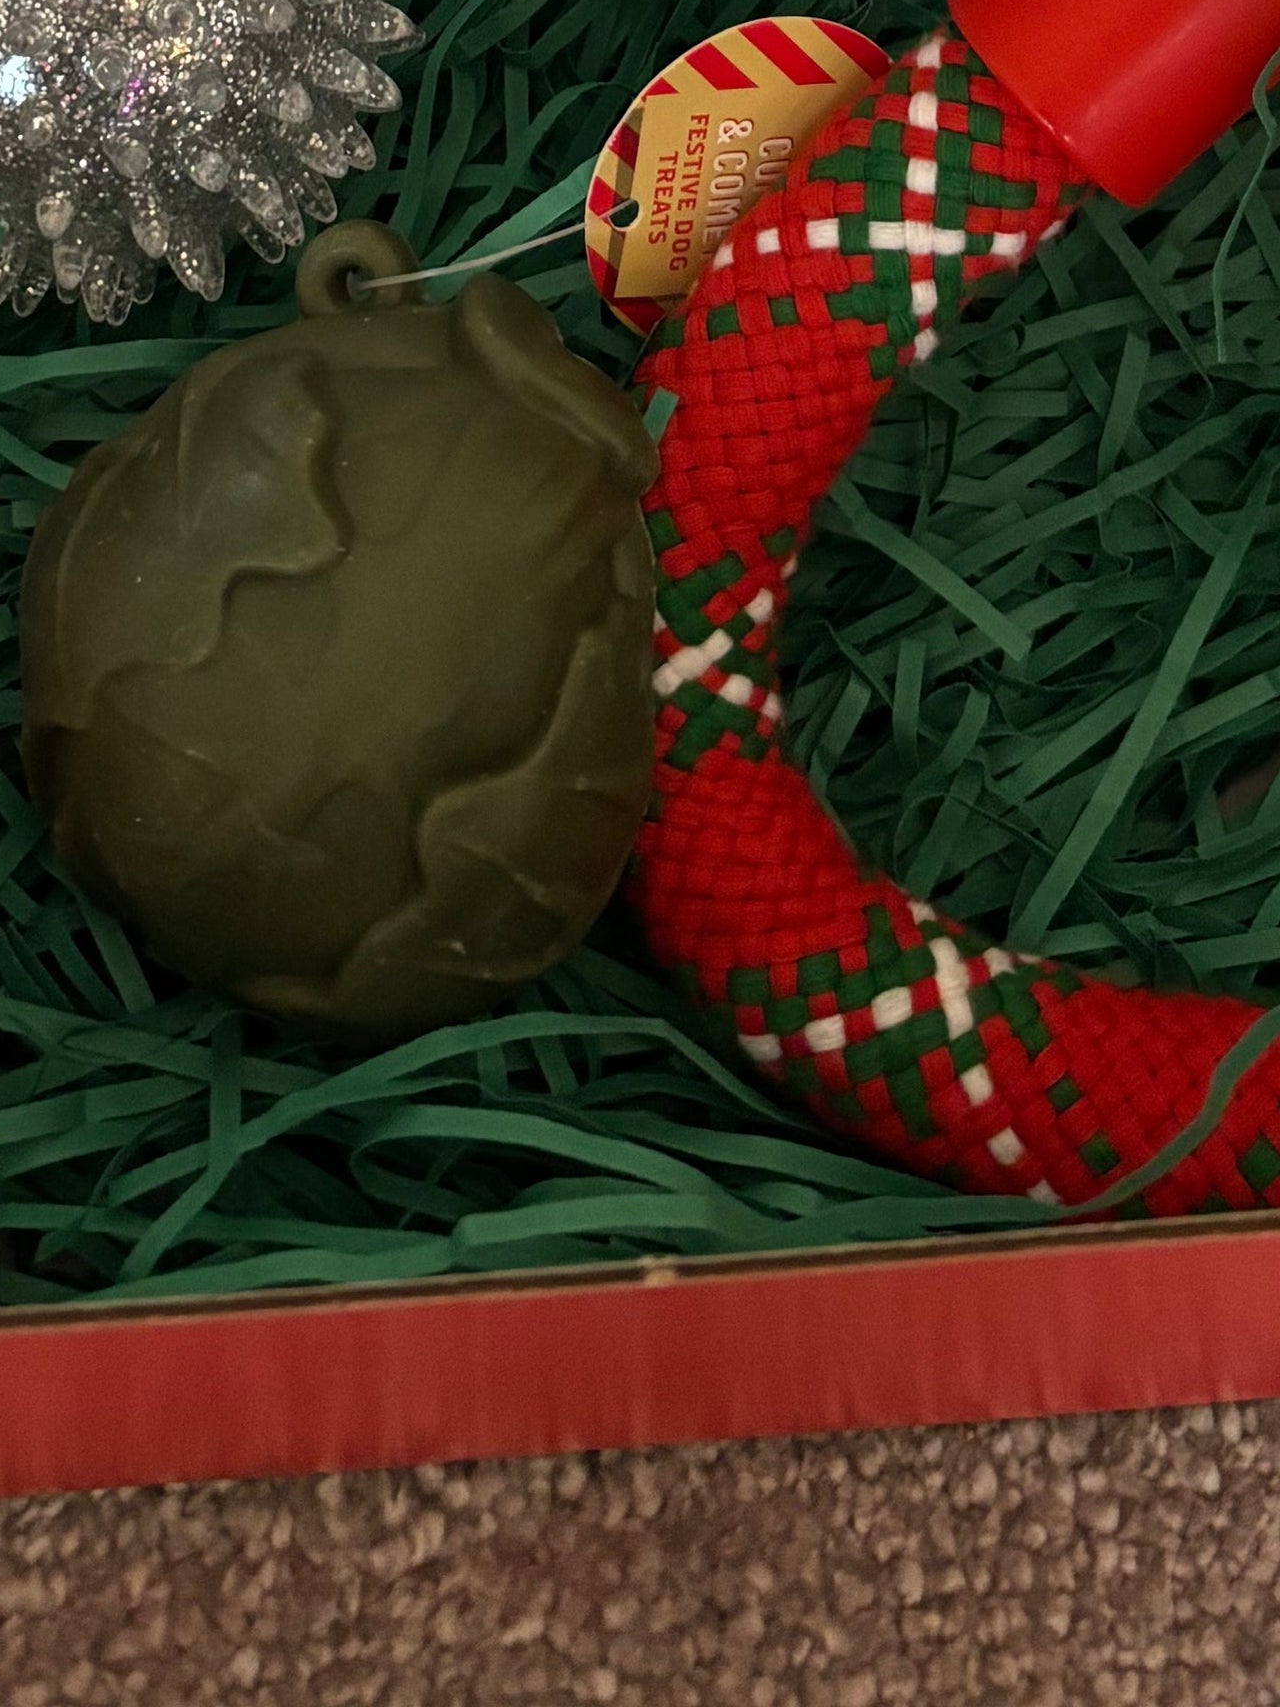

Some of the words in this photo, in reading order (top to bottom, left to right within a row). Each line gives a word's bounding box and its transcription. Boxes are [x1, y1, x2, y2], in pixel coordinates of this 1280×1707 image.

[677, 114, 710, 211] FESTIVE
[717, 117, 755, 145] &
[648, 150, 678, 246] TREATS
[669, 219, 694, 271] DOG
